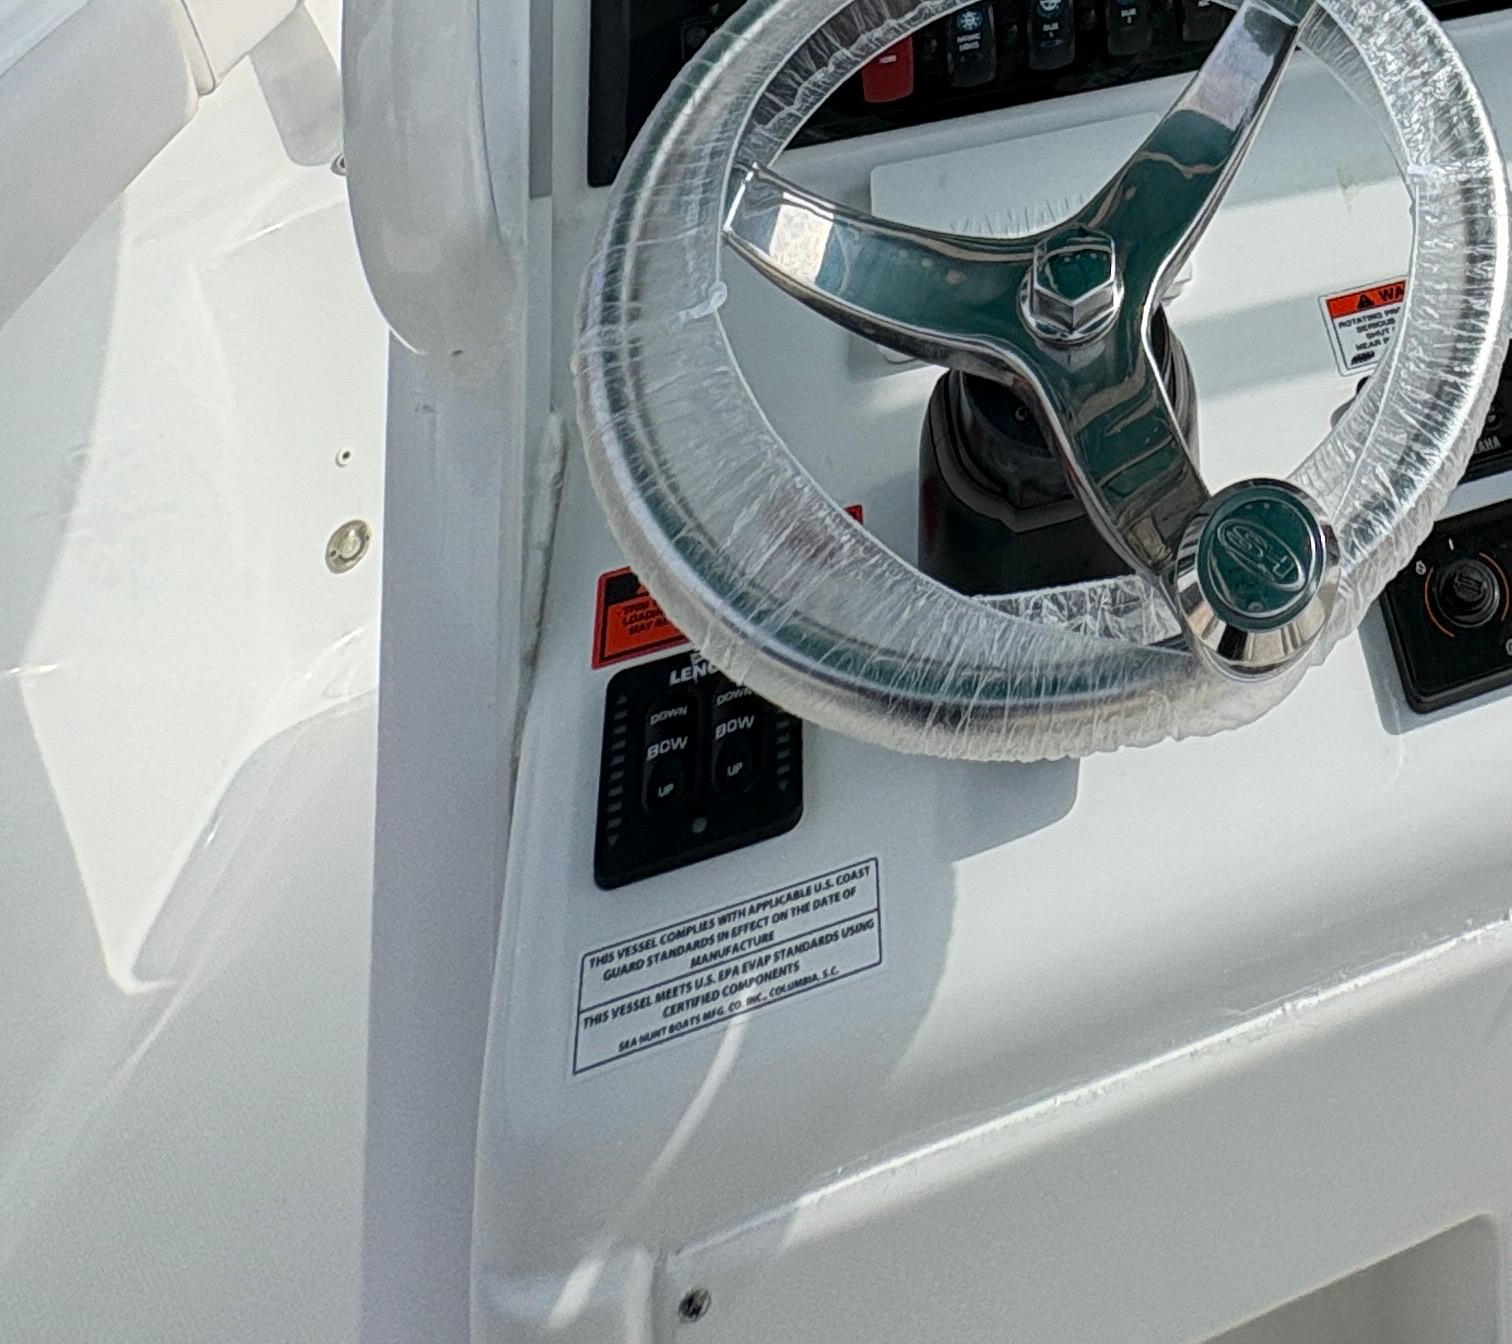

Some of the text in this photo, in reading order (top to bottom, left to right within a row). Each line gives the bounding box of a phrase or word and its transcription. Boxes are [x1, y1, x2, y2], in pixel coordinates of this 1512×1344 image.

[650, 706, 689, 726] DOWN
[715, 715, 756, 741] BOW
[646, 736, 689, 762] BOW
[727, 762, 743, 777] UP
[657, 783, 674, 798] UP
[589, 866, 871, 969] THIS VESSEL COMPLIES WITH APPLICABLE U.S. COAST
[603, 886, 857, 982] GUARD STANDARDS IN EFFECT ON THE DATE OF
[690, 930, 775, 969] MANUFACTURE
[583, 918, 875, 1030] THIS VESSEL MEETS U.S. EPA EVAP STANDARDS USING
[662, 960, 800, 1019] CERTIFIED COMPONENTS
[618, 1037, 638, 1052] SEA
[639, 1026, 668, 1046] HUNT
[669, 1014, 701, 1034] BOATS
[823, 965, 840, 979] S.C.
